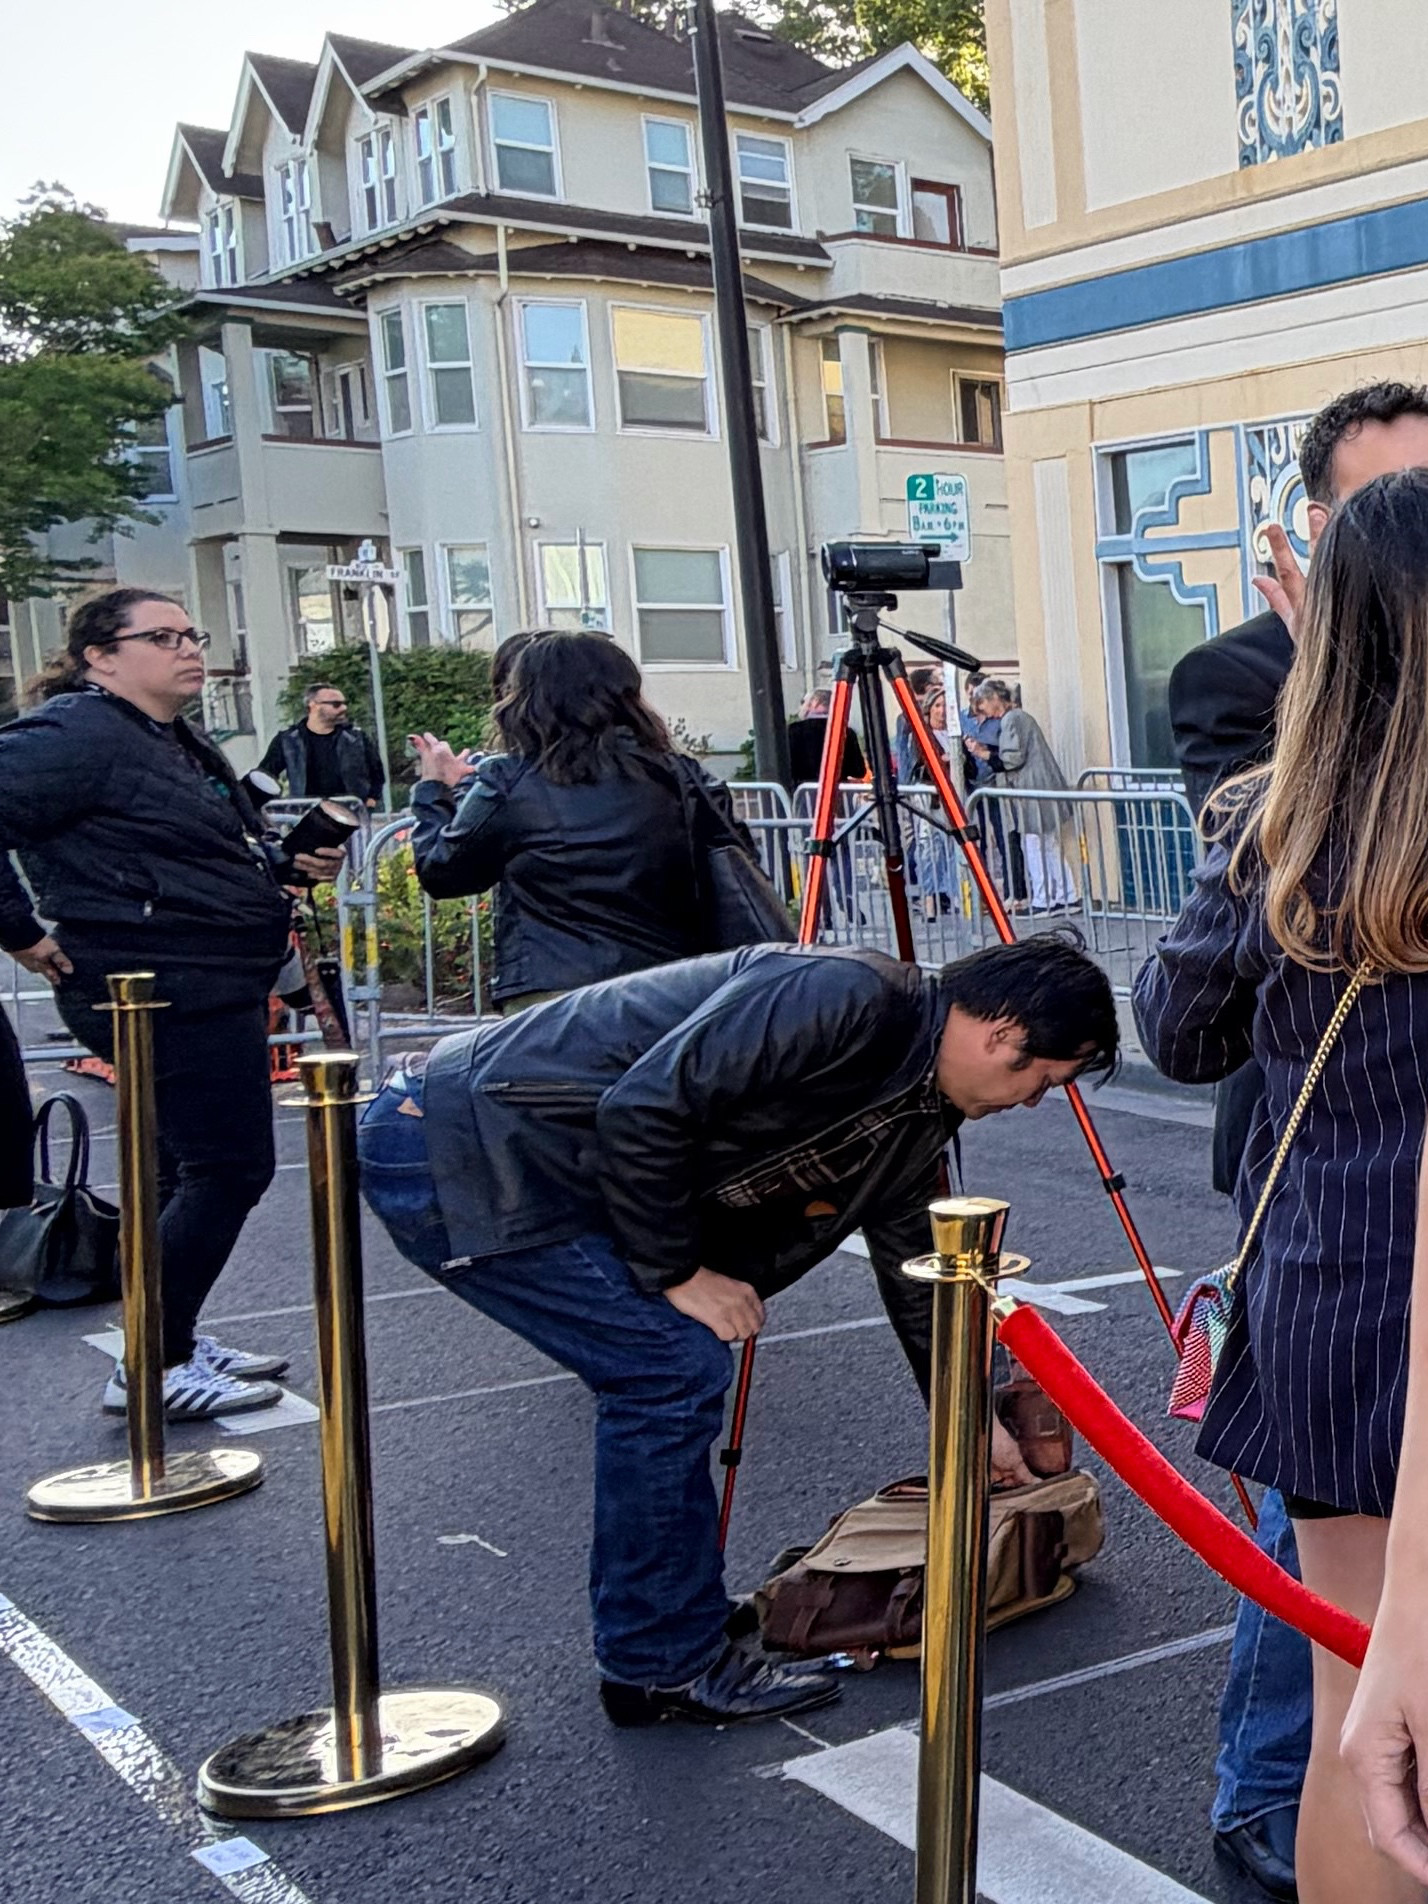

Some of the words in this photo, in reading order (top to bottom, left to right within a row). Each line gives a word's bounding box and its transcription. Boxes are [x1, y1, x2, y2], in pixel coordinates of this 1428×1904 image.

[915, 478, 927, 498] 2
[936, 479, 964, 496] HOUR
[919, 502, 958, 515] PARKING
[330, 567, 383, 580] FRANKLIN
